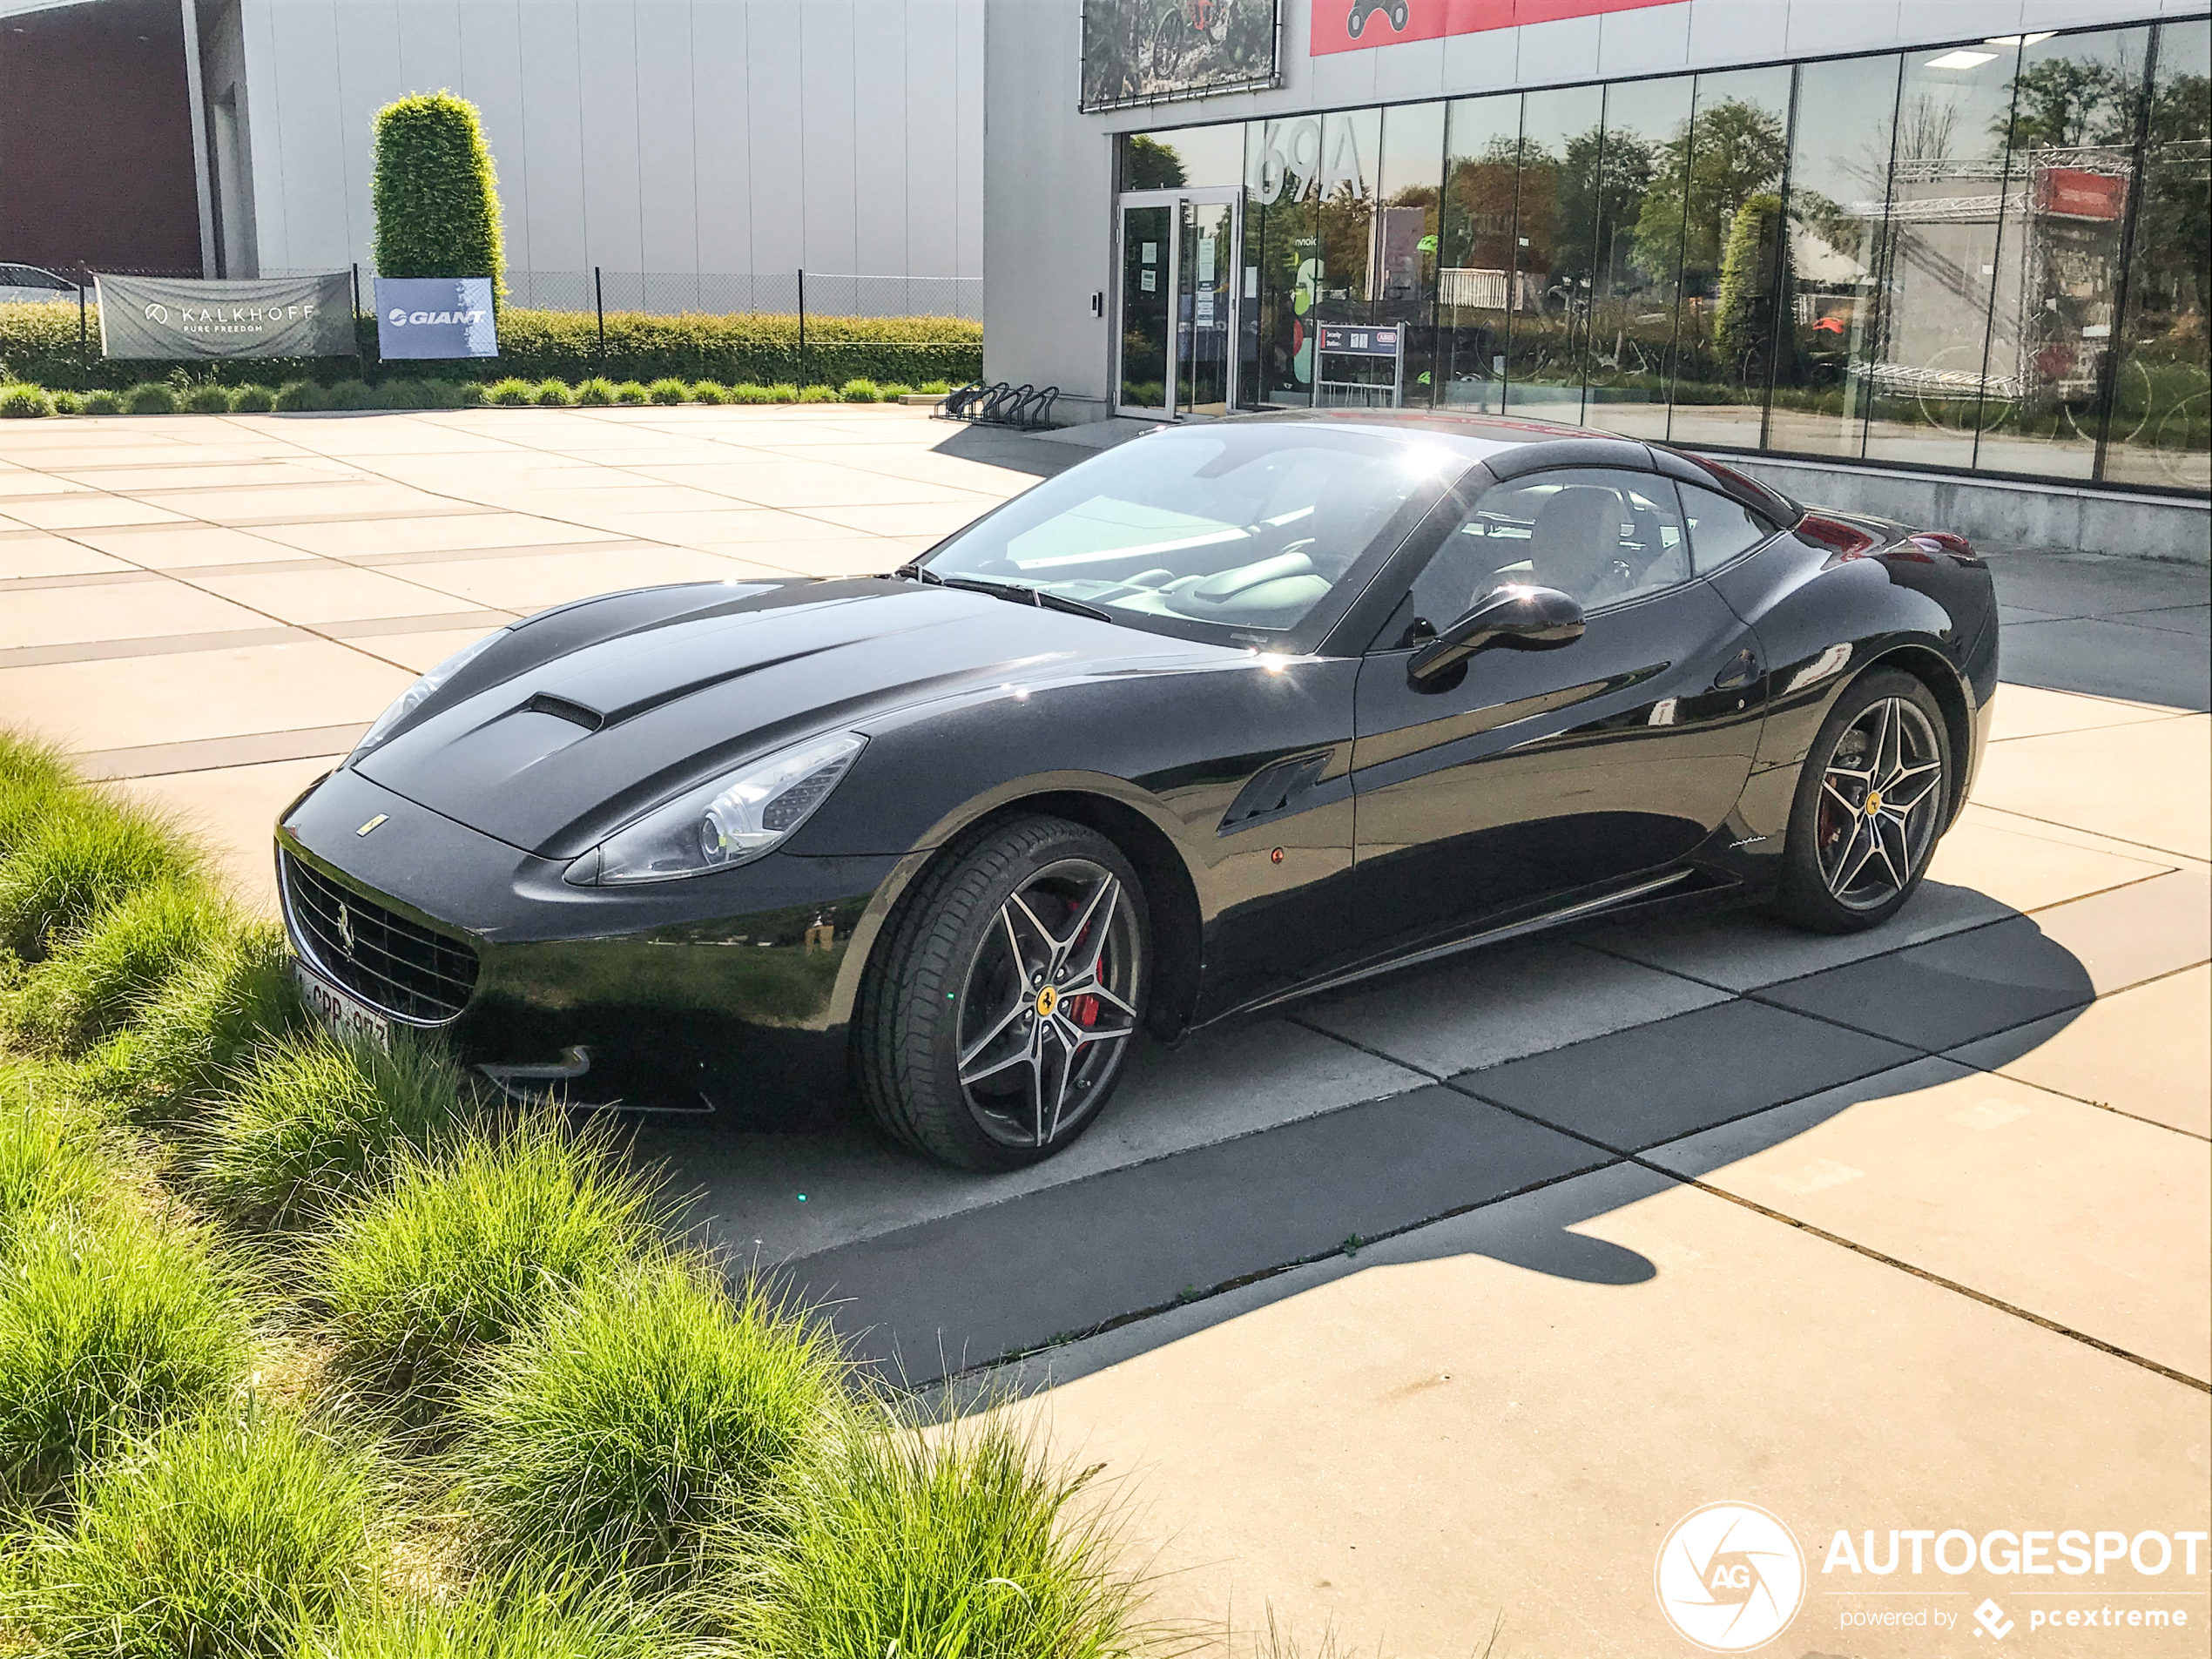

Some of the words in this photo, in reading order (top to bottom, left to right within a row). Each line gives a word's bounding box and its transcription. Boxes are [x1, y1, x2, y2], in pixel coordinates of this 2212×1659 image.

[1253, 116, 1363, 206] 69A
[181, 305, 314, 322] KALKHOFF
[409, 310, 486, 325] GIANT
